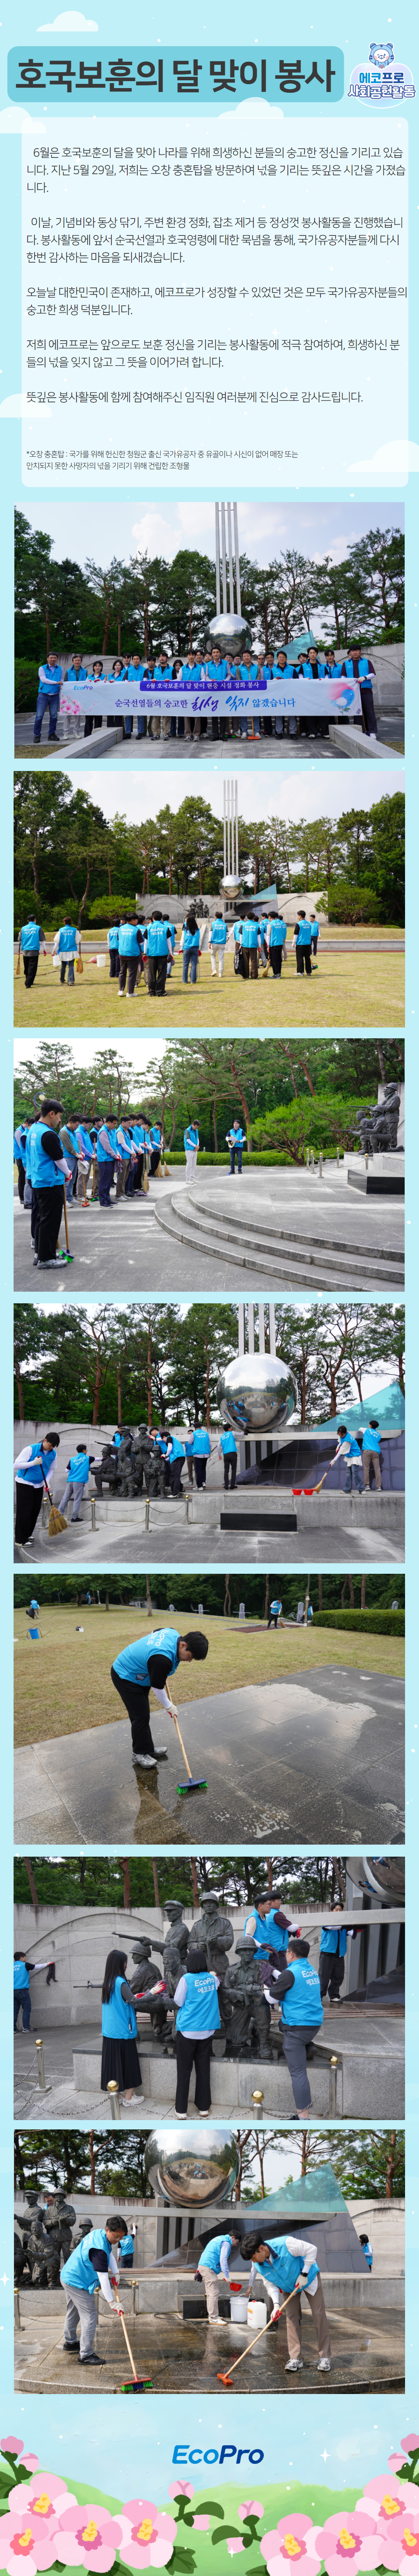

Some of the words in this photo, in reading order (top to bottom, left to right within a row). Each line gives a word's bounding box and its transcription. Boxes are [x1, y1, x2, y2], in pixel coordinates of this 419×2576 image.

[115, 699, 161, 708] 순국선열들의
[164, 699, 188, 708] 숭고한
[191, 696, 219, 712] 희생
[225, 695, 249, 712] 잊지
[252, 698, 296, 708] 않겠습니다
[197, 1985, 215, 1994] 에코프로
